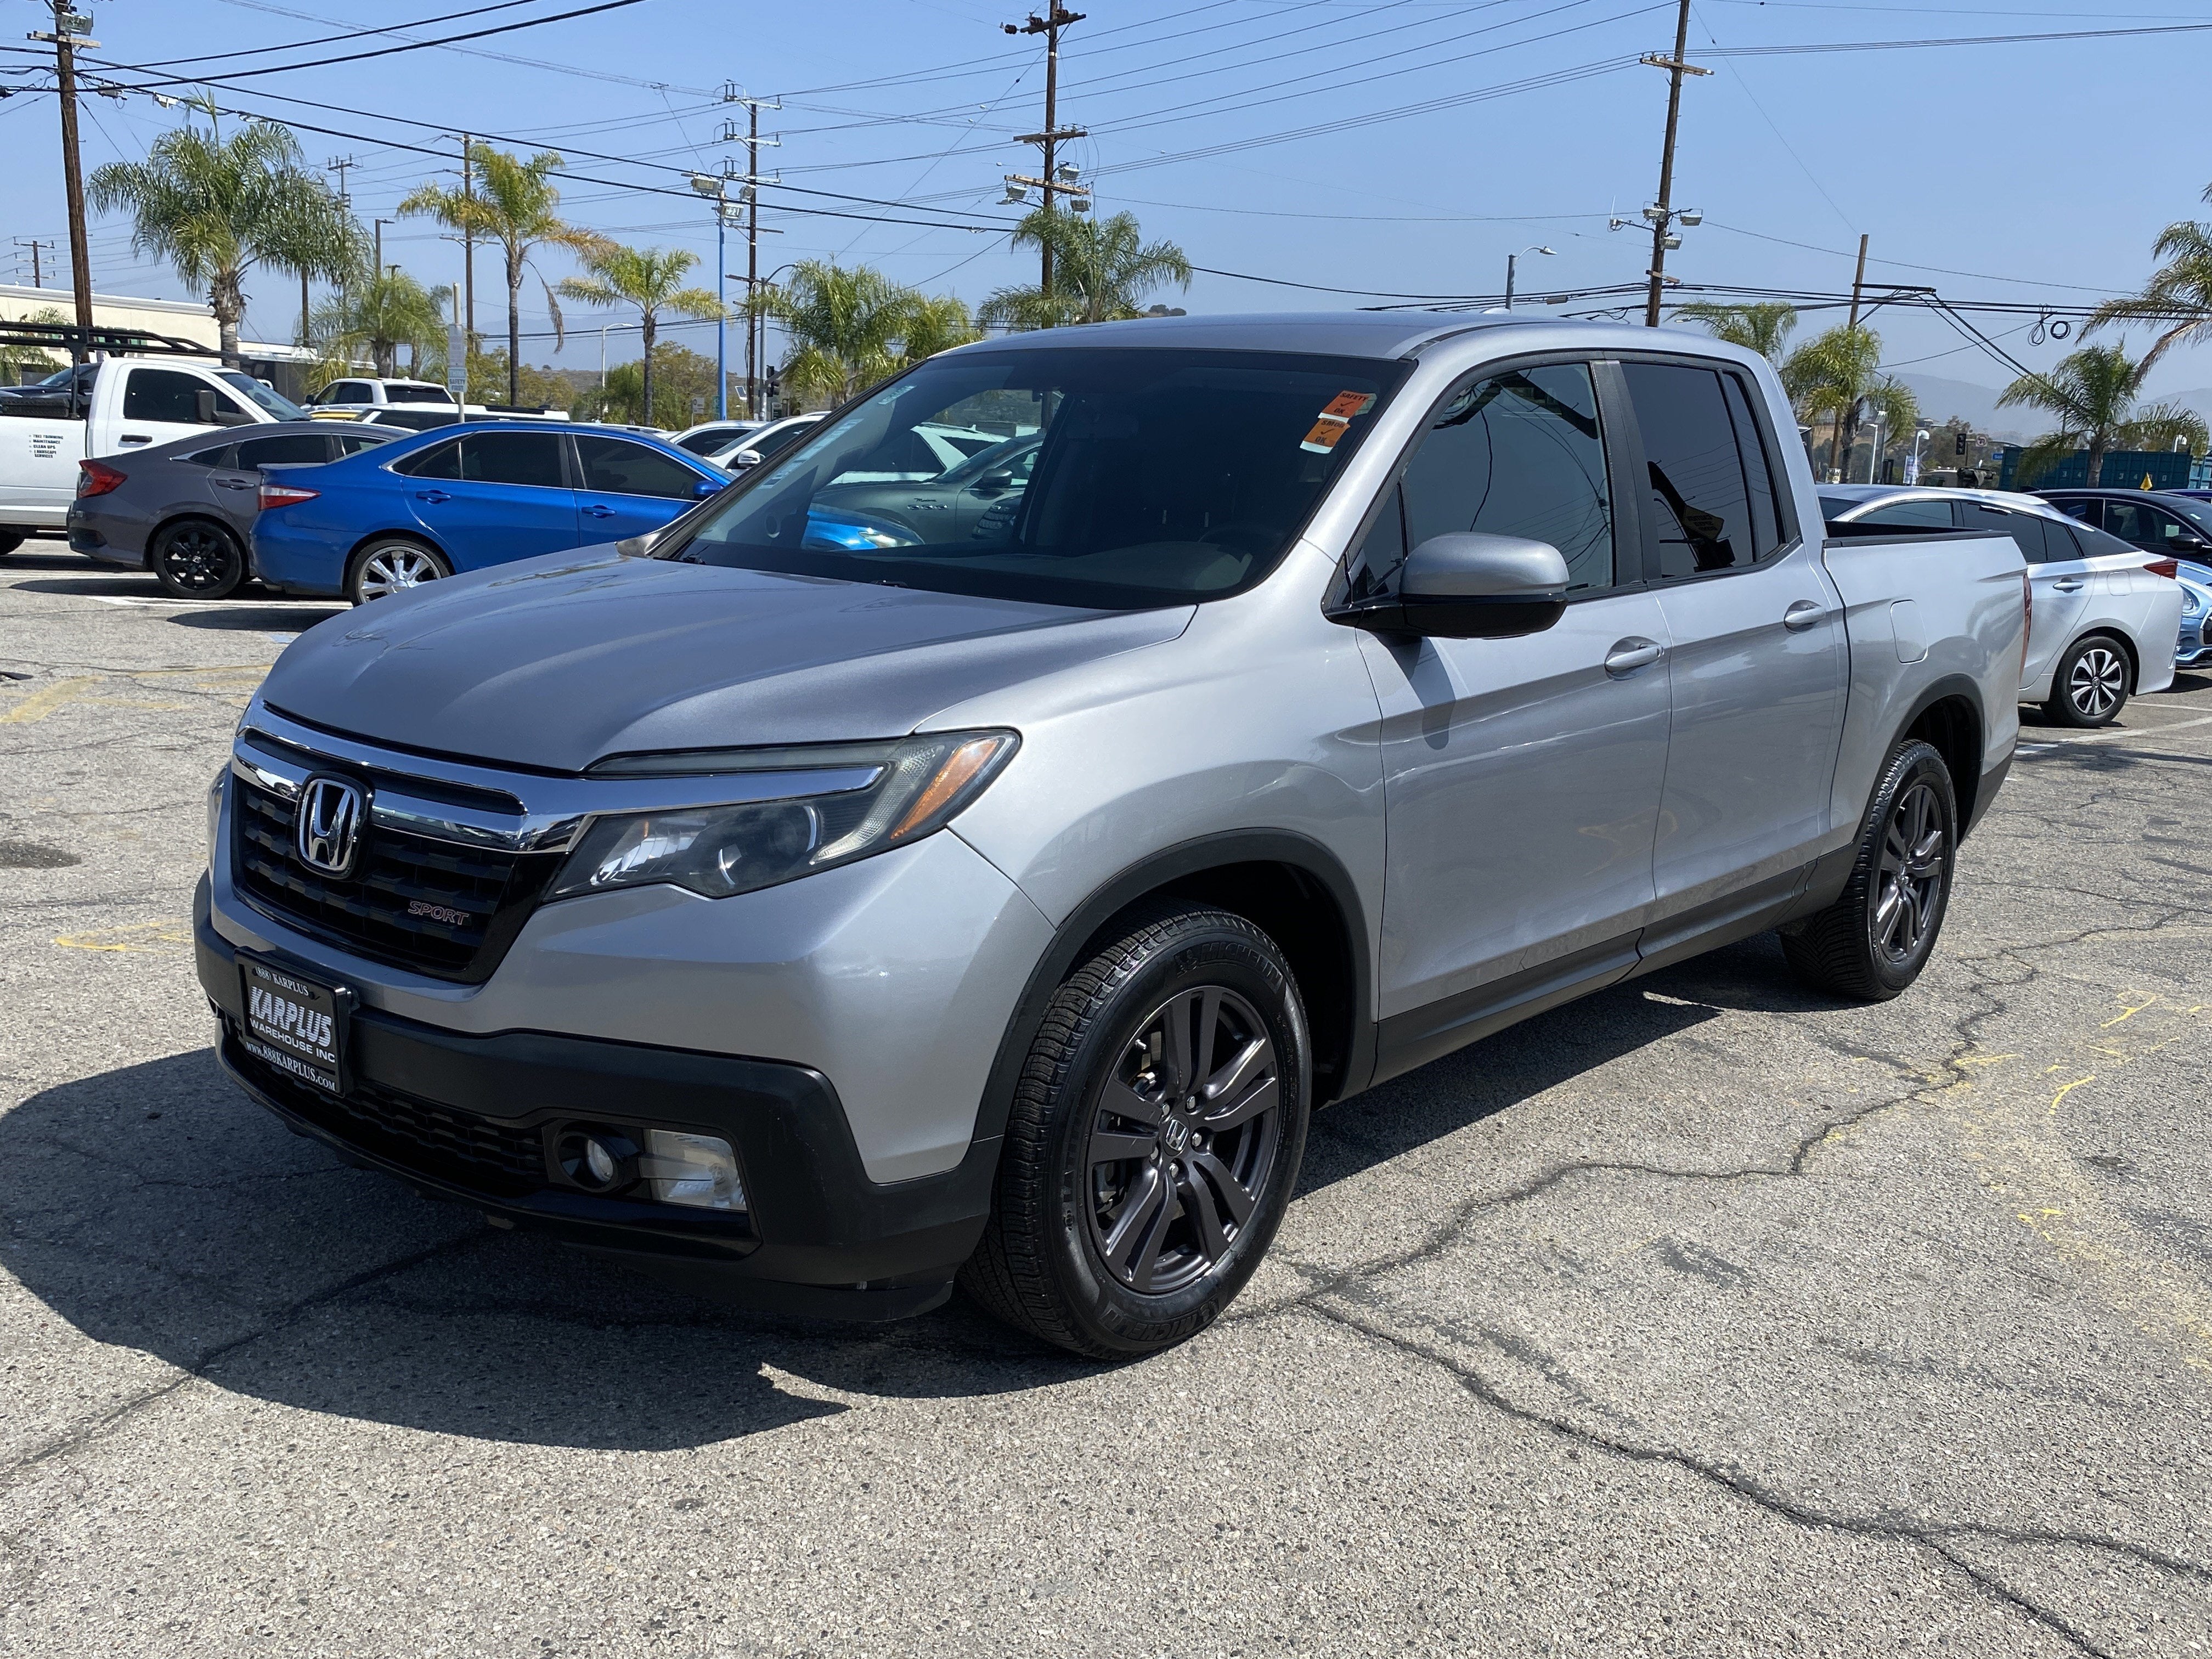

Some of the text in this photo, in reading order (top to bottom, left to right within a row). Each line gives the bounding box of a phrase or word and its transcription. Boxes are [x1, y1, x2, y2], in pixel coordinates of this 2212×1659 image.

[1340, 392, 1369, 402] SAFETY
[408, 901, 470, 925] SPORT
[255, 966, 309, 996] (888) KARPLUS
[1200, 941, 1284, 994] MICHELIN
[249, 986, 332, 1047] KARPLUS
[250, 1018, 336, 1063] WAREHOUSE INC
[1097, 1300, 1198, 1341] MICHELIN
